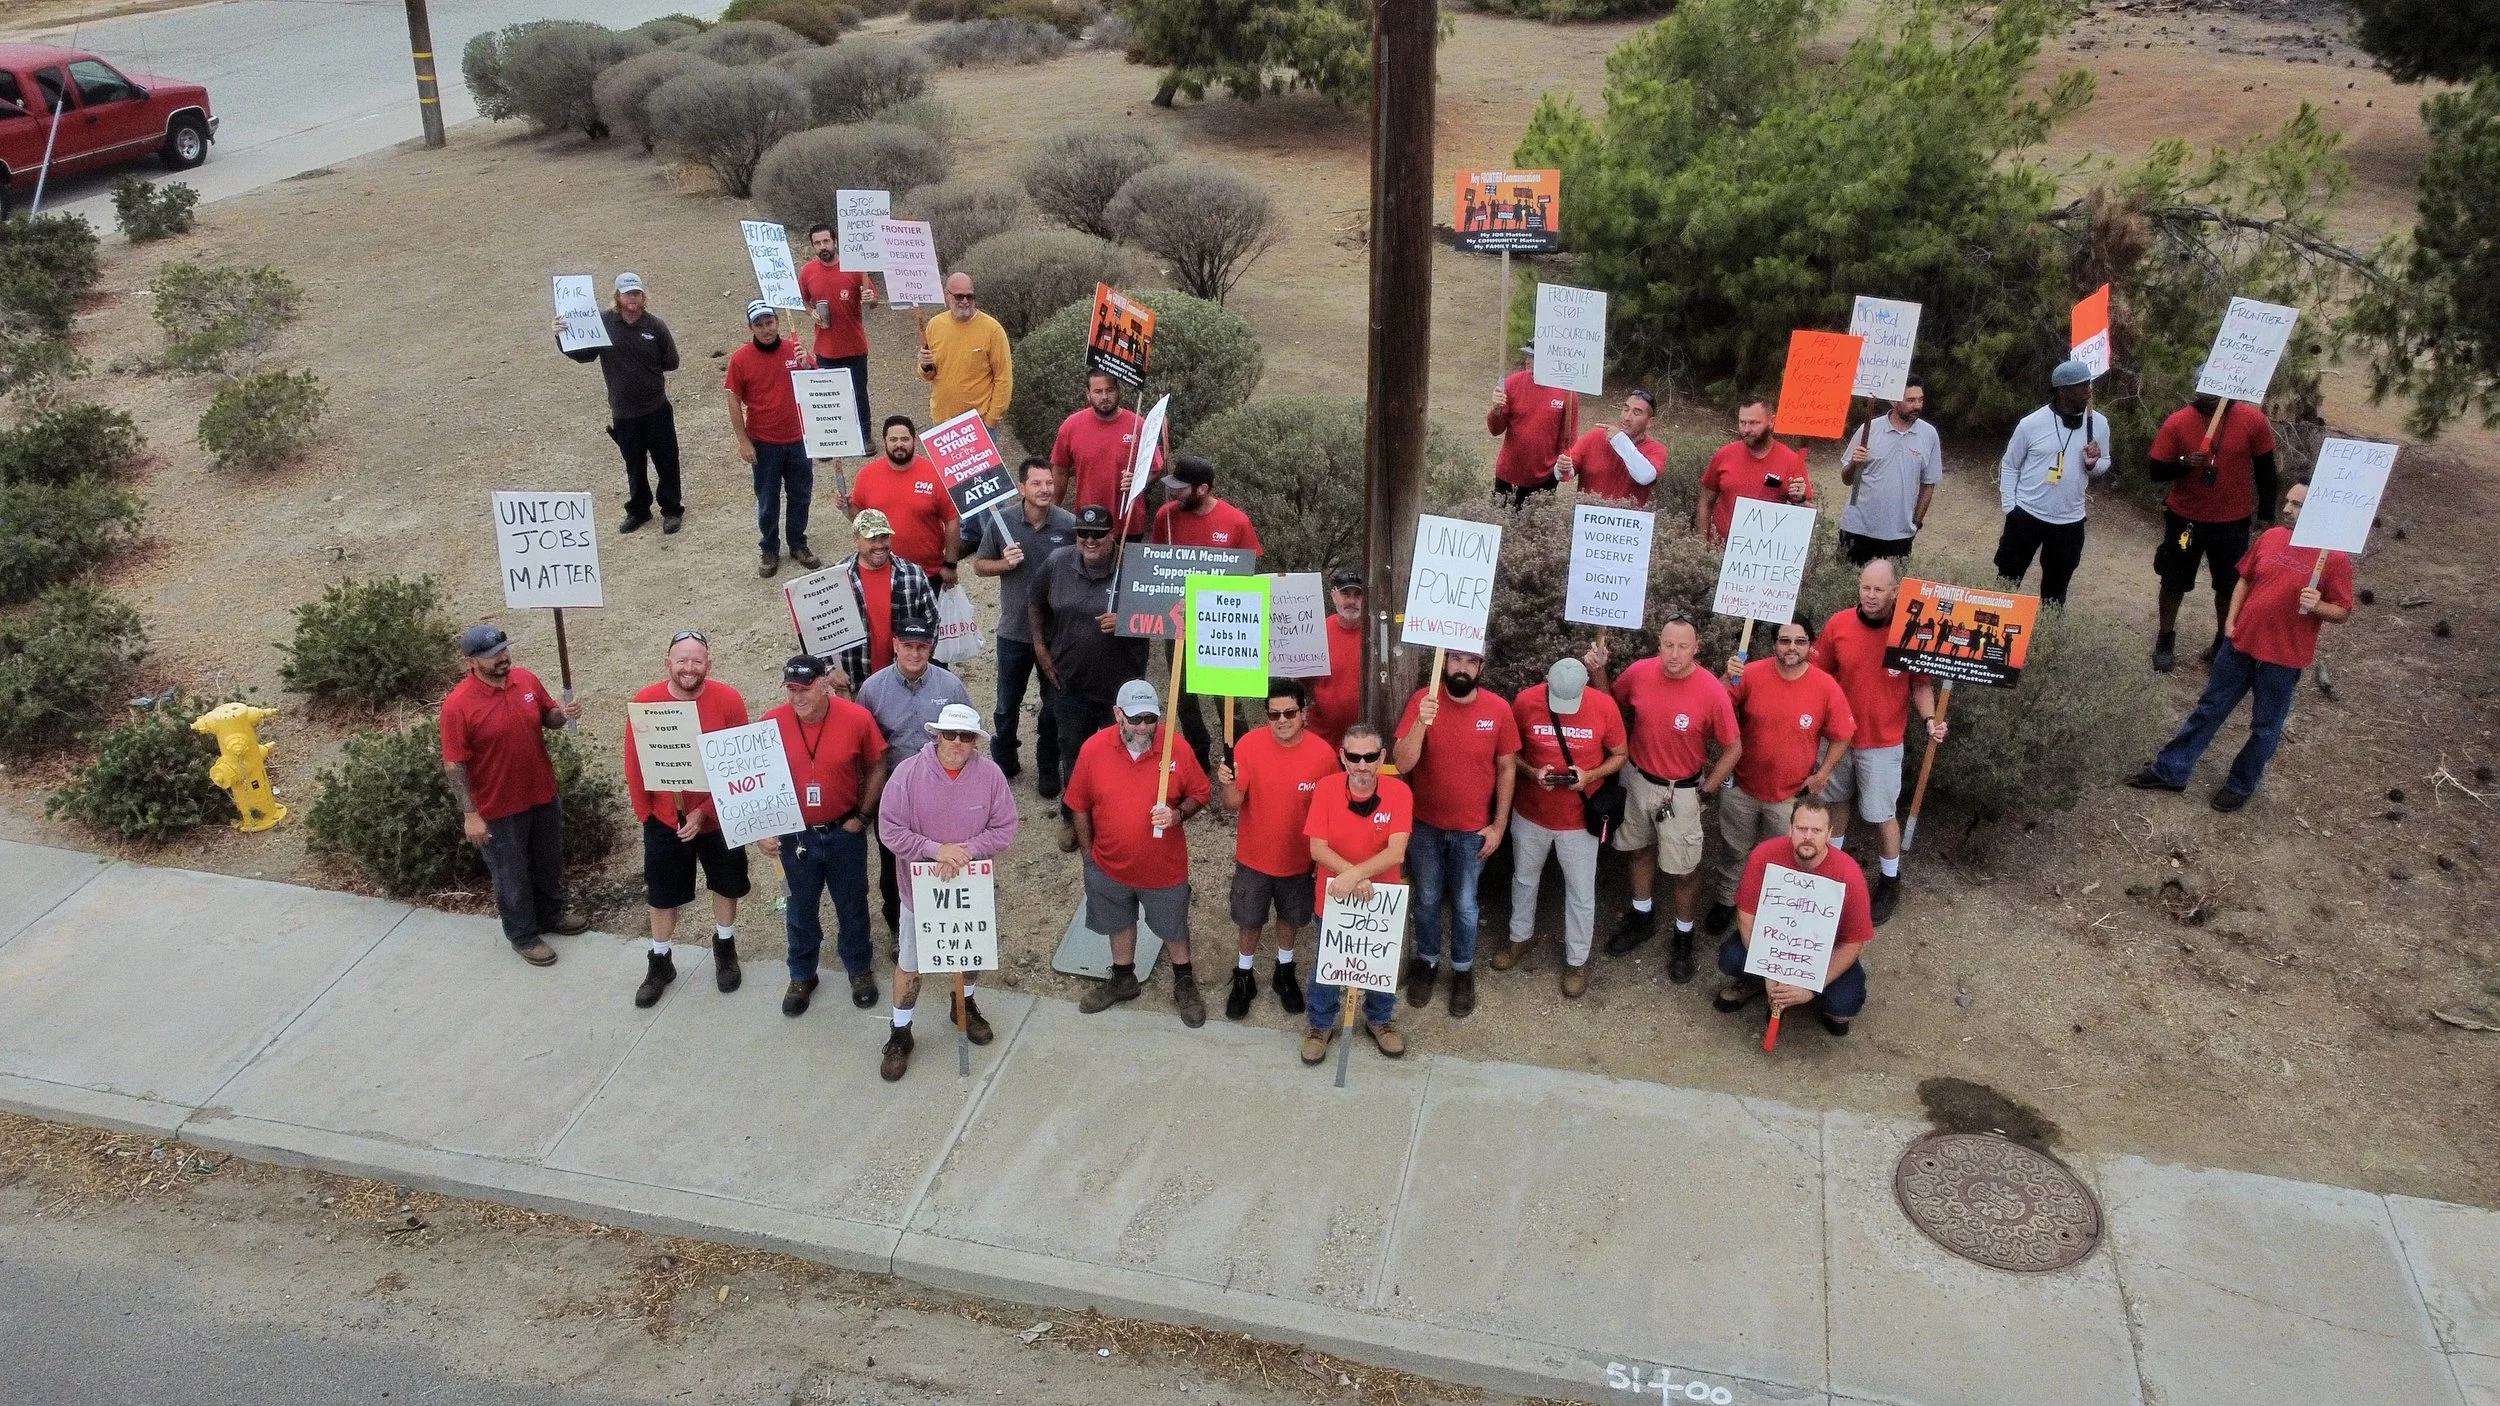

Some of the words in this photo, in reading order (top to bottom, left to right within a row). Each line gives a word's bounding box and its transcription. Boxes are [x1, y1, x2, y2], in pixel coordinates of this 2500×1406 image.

[1480, 172, 1503, 184] FRONTIER
[1503, 171, 1541, 183] Communications
[849, 197, 874, 209] STOP
[840, 208, 889, 217] OUTSOURCING
[848, 232, 875, 243] JOBS
[885, 238, 926, 248] WORKERS
[748, 244, 779, 258] RESPECT
[843, 243, 864, 253] CWA
[889, 250, 926, 260] DESERVE
[895, 268, 927, 278] DIGNITY
[555, 278, 587, 300] FAIR
[905, 281, 923, 290] AND
[900, 292, 933, 302] RESPECT
[1548, 287, 1593, 304] FRONTIER
[565, 323, 600, 341] NOW
[1537, 325, 1601, 342] OUTSOURCING
[2239, 332, 2257, 343] MY
[1812, 335, 1840, 353] HEY
[2081, 336, 2106, 358] GOOD
[2220, 336, 2275, 357] EXISTENCE
[2232, 352, 2253, 363] OR
[2202, 376, 2265, 398] RESISTANCE
[2227, 374, 2247, 385] MY
[933, 430, 961, 448] CWA
[960, 423, 976, 435] on
[938, 431, 979, 456] STRIKE
[943, 448, 993, 477] American
[951, 452, 963, 462] For
[2325, 442, 2362, 461] KEEP
[2362, 448, 2393, 469] JOBS
[954, 461, 991, 482] Dream
[2334, 467, 2357, 480] IN
[915, 481, 934, 491] CWA
[974, 475, 984, 485] At
[964, 476, 1000, 505] AT&T
[2310, 486, 2378, 508] AMERICA
[500, 498, 586, 525] UNION
[1584, 513, 1643, 531] FRONTIER,
[1743, 508, 1789, 533] MY
[512, 530, 590, 554] JOBS
[1212, 532, 1228, 540] CWA
[1584, 530, 1640, 547] WORKERS
[1427, 525, 1494, 564] UNION
[1730, 535, 1804, 564] FAMILY
[1143, 547, 1174, 559] Proud
[1175, 548, 1196, 561] CWA
[1199, 550, 1240, 563] Member
[1585, 548, 1634, 563] DESERVE
[510, 564, 597, 592] MATTER
[1153, 565, 1208, 580] Supporting
[1211, 568, 1226, 576] MY
[1585, 572, 1631, 586] DIGNITY
[1727, 561, 1803, 586] MATTERS
[809, 576, 826, 586] CWA
[1132, 581, 1185, 596] Bargaining
[1415, 568, 1488, 610] POWER
[1723, 581, 1756, 593] THEIR
[803, 583, 839, 599] FIGHTING
[1273, 590, 1315, 604] ontier
[1593, 590, 1618, 601] AND
[1920, 583, 1934, 599] Hey
[1933, 585, 1964, 603] FRONTIER
[1965, 591, 2014, 609] Communications
[1217, 595, 1242, 608] Keep
[1721, 595, 1749, 607] HOMES
[811, 605, 844, 621] PROVIDE
[1198, 612, 1260, 624] CALIFORNIA
[1298, 609, 1313, 622] ON
[1581, 605, 1629, 619] RESPECT
[817, 617, 846, 631] BETTER
[1129, 613, 1165, 634] CWA
[1408, 616, 1485, 640] #CWASTRONG
[819, 627, 850, 641] SERVICE
[1210, 629, 1233, 640] Jobs
[1237, 630, 1247, 640] In
[1198, 645, 1259, 658] CALIFORNIA
[1900, 656, 1912, 664] My
[1915, 659, 1968, 672] COMMUNITY
[1970, 669, 2004, 679] Matters
[1919, 654, 1933, 662] My
[1935, 656, 1952, 664] JOB
[1954, 659, 1988, 670] Matters
[1908, 665, 1922, 674] My
[1923, 668, 1955, 678] FAMILY
[1958, 673, 1992, 684] Matters
[1476, 720, 1494, 728] CWA
[706, 728, 781, 759] CUSTOMER
[718, 754, 771, 778] SERVICE
[728, 773, 766, 795] NOT
[1298, 783, 1316, 791] CWA
[722, 792, 798, 821] CORPORATE
[734, 811, 789, 837] GREED
[913, 863, 991, 876] UNED
[1783, 872, 1815, 890] CWA
[933, 888, 970, 909] WE
[923, 920, 987, 933] STAND
[937, 939, 973, 950] CWA
[1764, 926, 1825, 952] PROVIDE
[933, 955, 983, 966] 9588
[1346, 957, 1367, 971] NO
[1769, 947, 1813, 965] BETTER
[1321, 962, 1392, 987] Contractors
[1756, 958, 1816, 980] SERVICES
